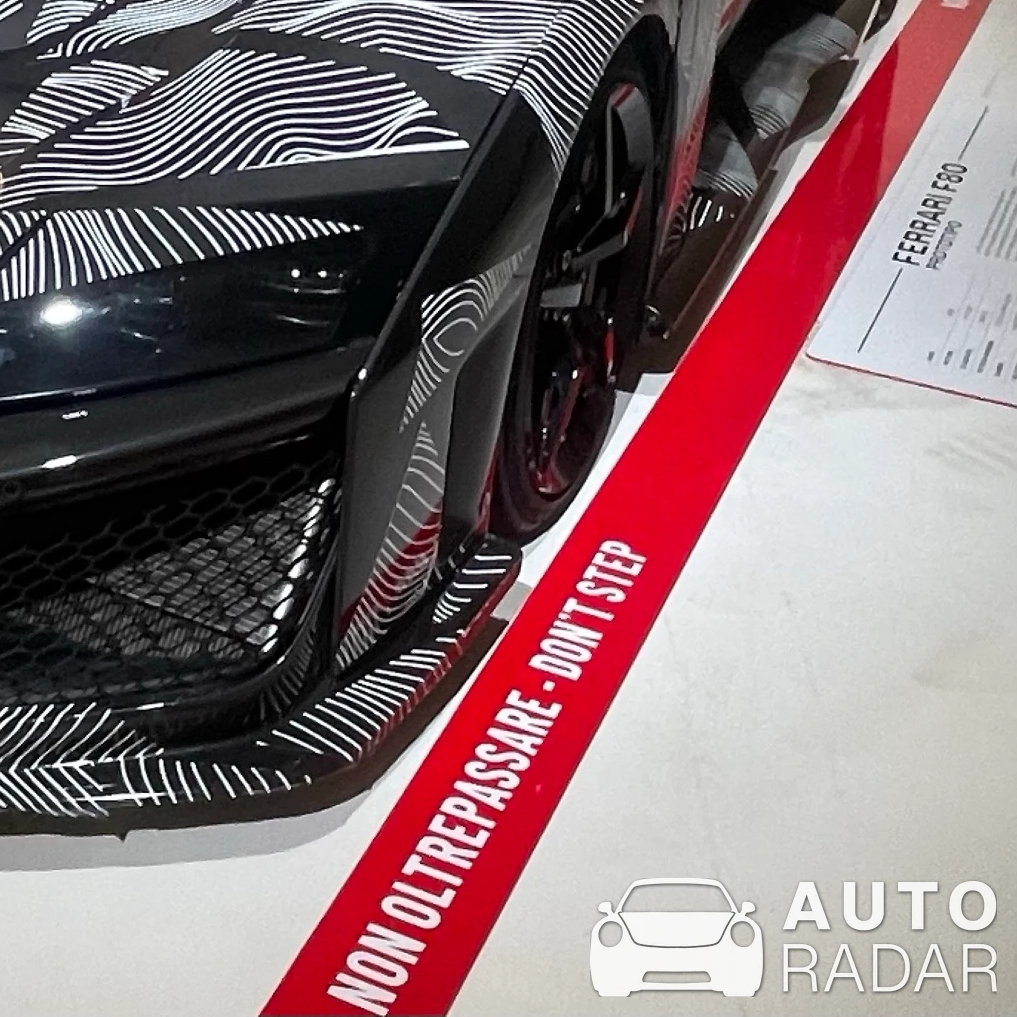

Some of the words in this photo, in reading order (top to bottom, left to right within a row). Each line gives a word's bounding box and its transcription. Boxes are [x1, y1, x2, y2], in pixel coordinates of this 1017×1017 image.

[891, 193, 953, 266] FERRARI
[931, 163, 968, 193] F80
[326, 922, 427, 1017] NON
[379, 689, 563, 930] OLTREPASSARE
[528, 597, 615, 682] DON'T
[576, 539, 648, 605] STEP
